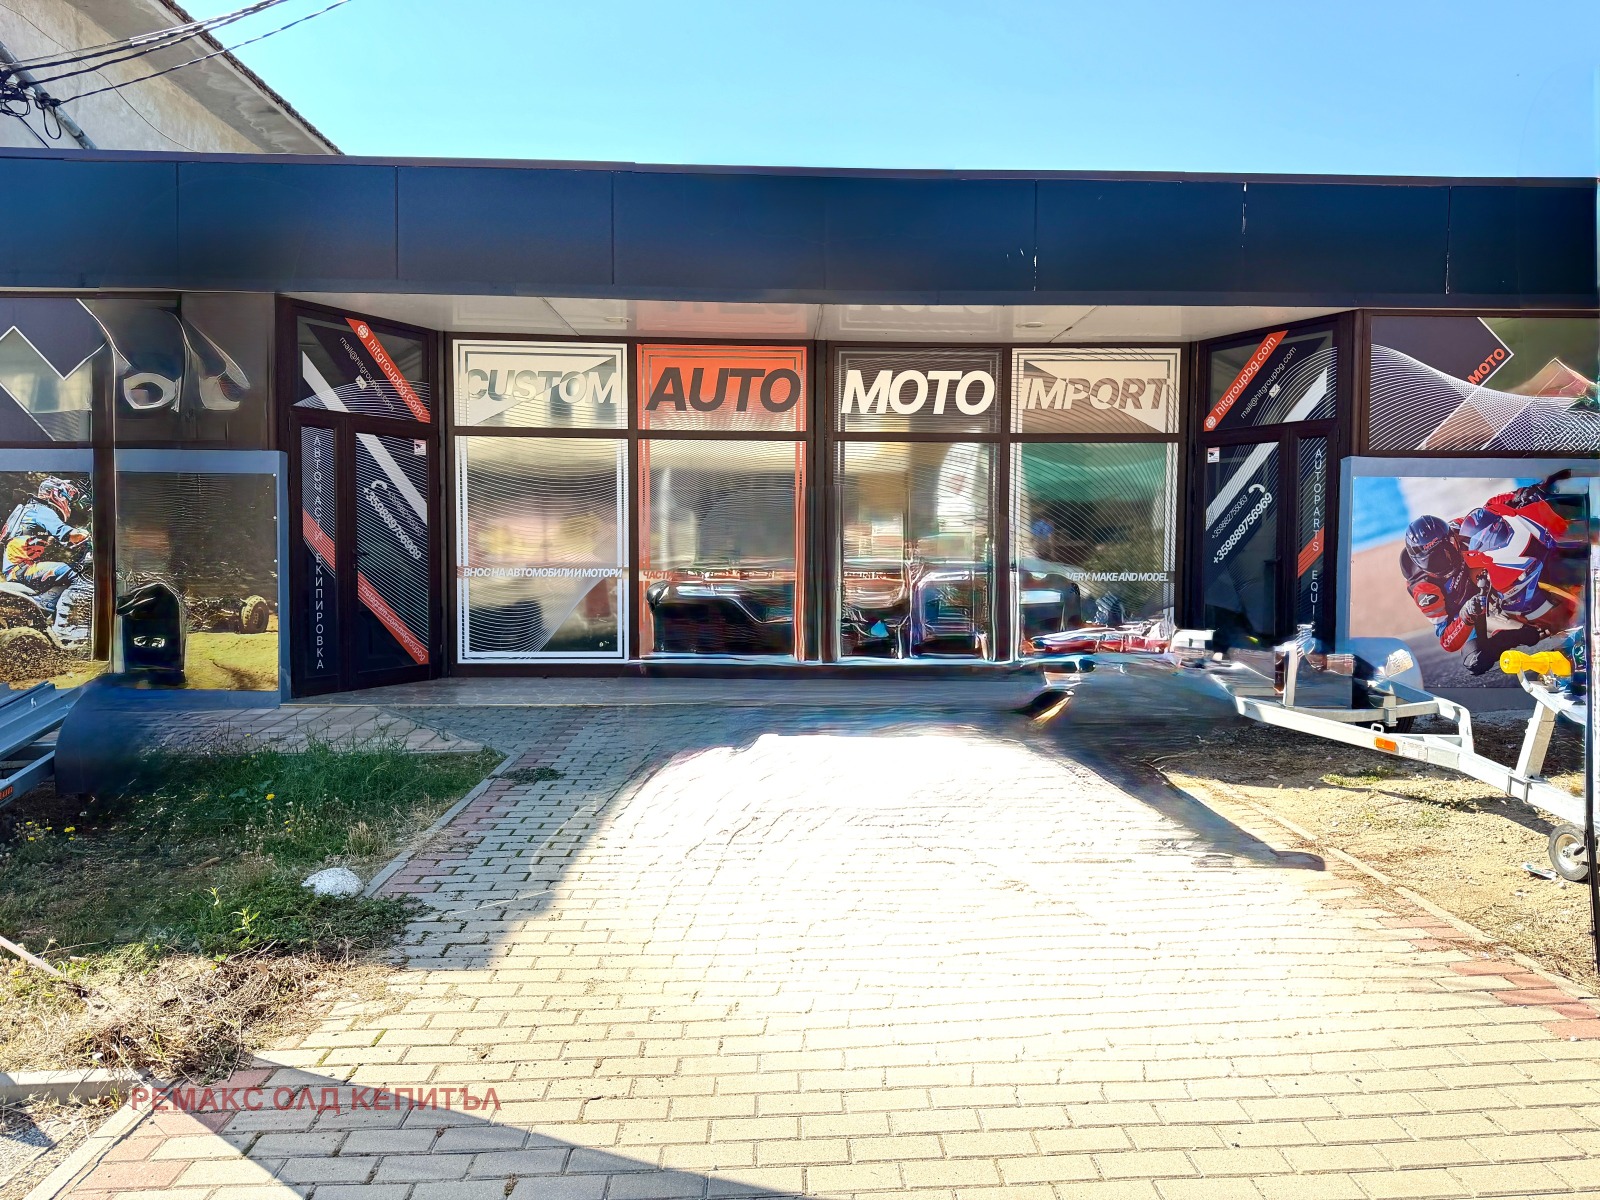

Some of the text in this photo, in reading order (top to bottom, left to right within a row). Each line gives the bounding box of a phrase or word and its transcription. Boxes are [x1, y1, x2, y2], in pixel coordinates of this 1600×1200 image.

[368, 338, 425, 418] hitgroupbg.com
[467, 368, 618, 404] CUSTOM
[1214, 335, 1278, 416] hitgroupbg.com
[1239, 345, 1297, 420] mail@hitgroupbg.com
[1467, 348, 1505, 385] MOTO
[645, 367, 801, 412] AUTO
[841, 369, 995, 415] MOTO
[1020, 377, 1168, 410] IMPORT
[1312, 448, 1323, 552] AUTOPARTS
[1212, 490, 1273, 566] +359889756969
[491, 568, 506, 577] НА
[508, 568, 574, 578] АВТОМОБИЛИ
[573, 568, 582, 578] И
[582, 568, 623, 578] МОТОРИ
[1066, 572, 1169, 582] VERY MAKE AND MODEL
